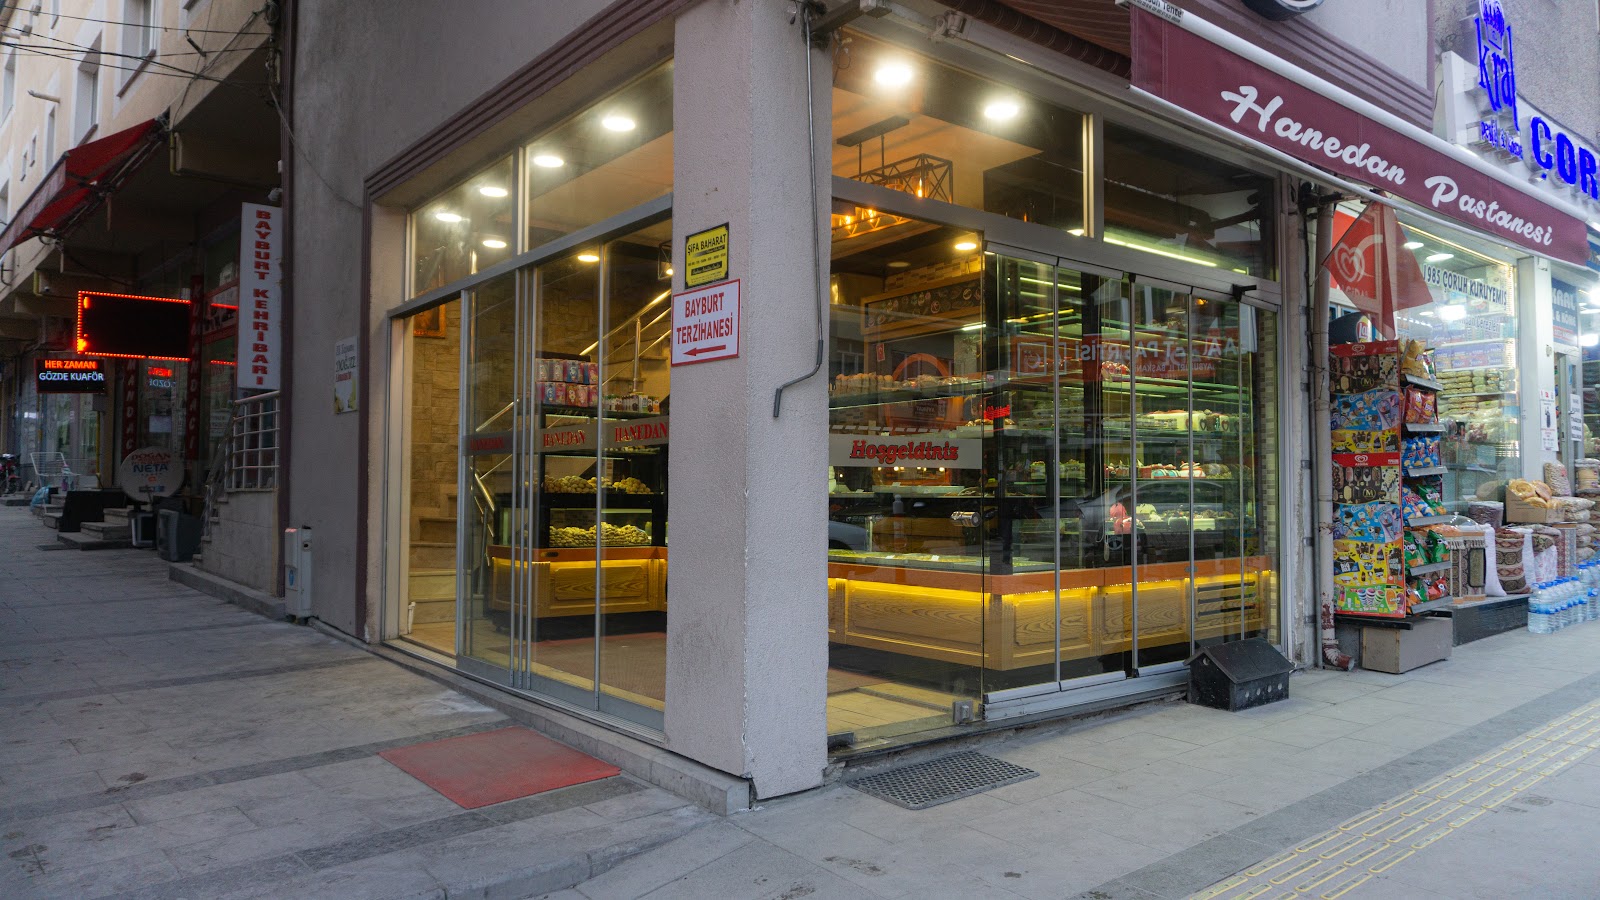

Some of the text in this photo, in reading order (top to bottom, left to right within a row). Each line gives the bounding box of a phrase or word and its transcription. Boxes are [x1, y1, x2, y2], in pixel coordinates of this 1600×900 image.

[1220, 84, 1553, 247] Hanedan Pastanesi
[1530, 116, 1600, 201] ÇOR
[254, 210, 272, 280] BAYBURT
[700, 233, 727, 250] BAHARAT
[1423, 265, 1441, 285] 1985
[1442, 270, 1468, 294] ÇORUH
[685, 292, 725, 318] BAYBURT
[676, 312, 733, 345] TERZİHANESİ
[39, 371, 104, 381] GÖZDE KUAFÖR
[45, 360, 98, 370] HER ZAMAN
[543, 430, 586, 448] HANEDAN
[615, 421, 668, 443] HANEDAN
[850, 439, 959, 464] Hoşgeldiniz
[133, 463, 168, 473] NETA
